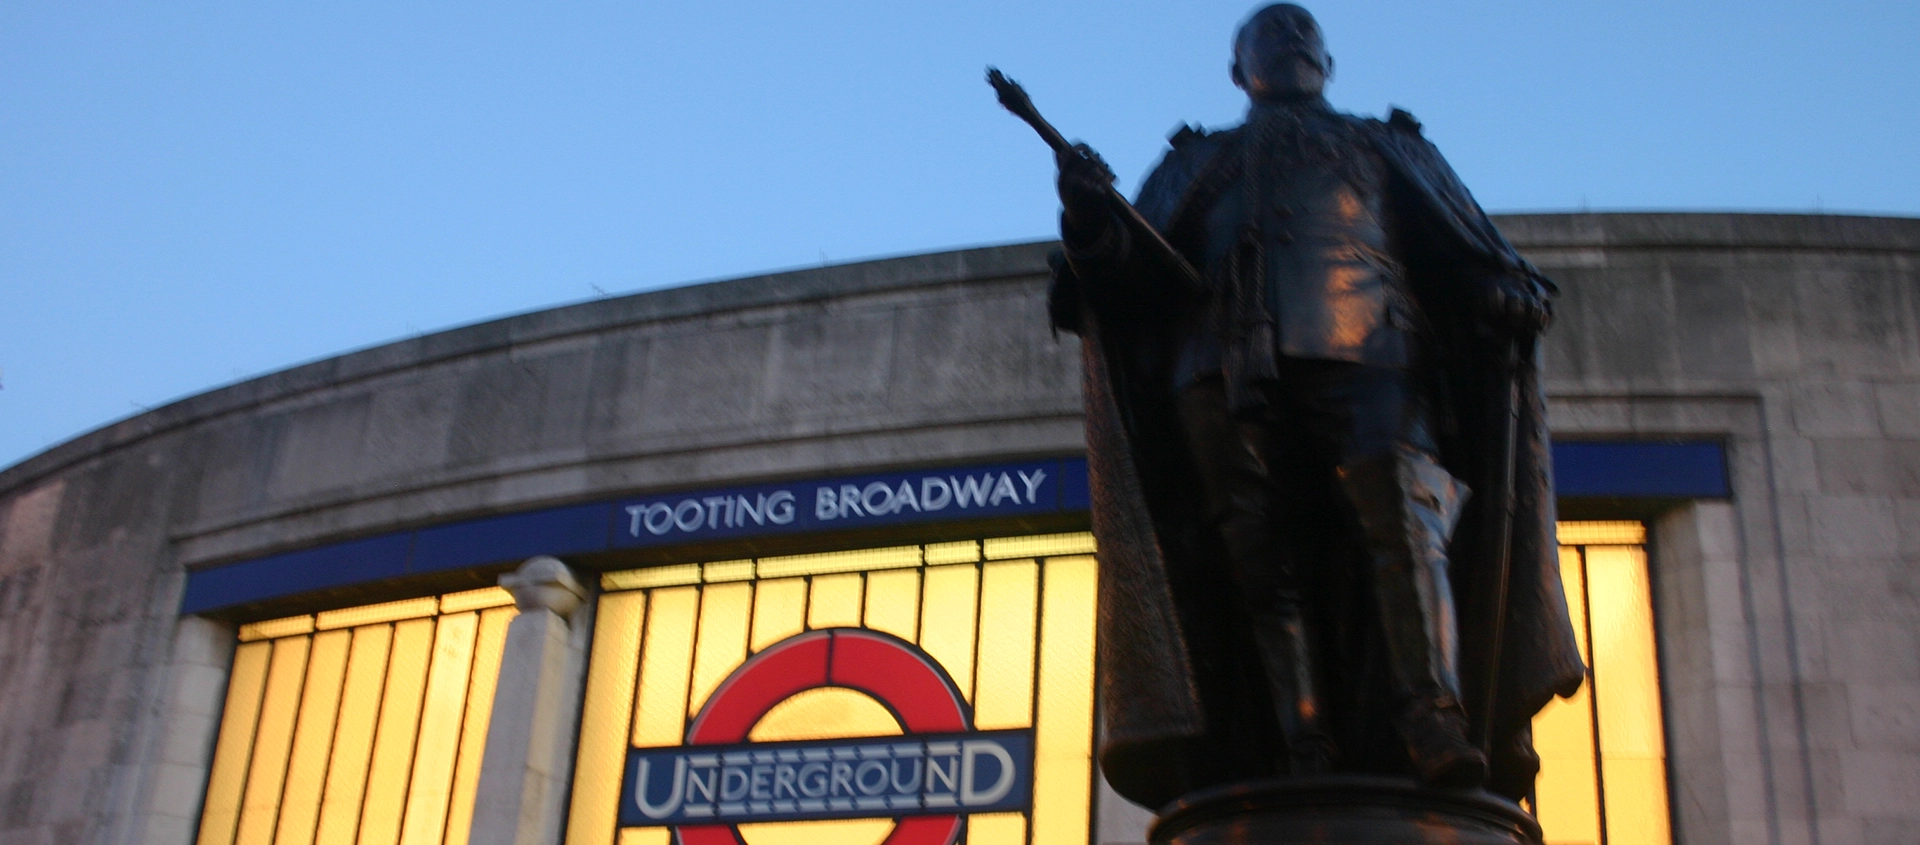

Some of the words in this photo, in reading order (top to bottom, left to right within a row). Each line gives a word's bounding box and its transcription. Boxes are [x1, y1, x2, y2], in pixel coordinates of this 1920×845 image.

[625, 490, 795, 537] TOOTING
[815, 468, 1046, 521] BROADWAY
[634, 740, 1016, 819] UNDERGROUND
